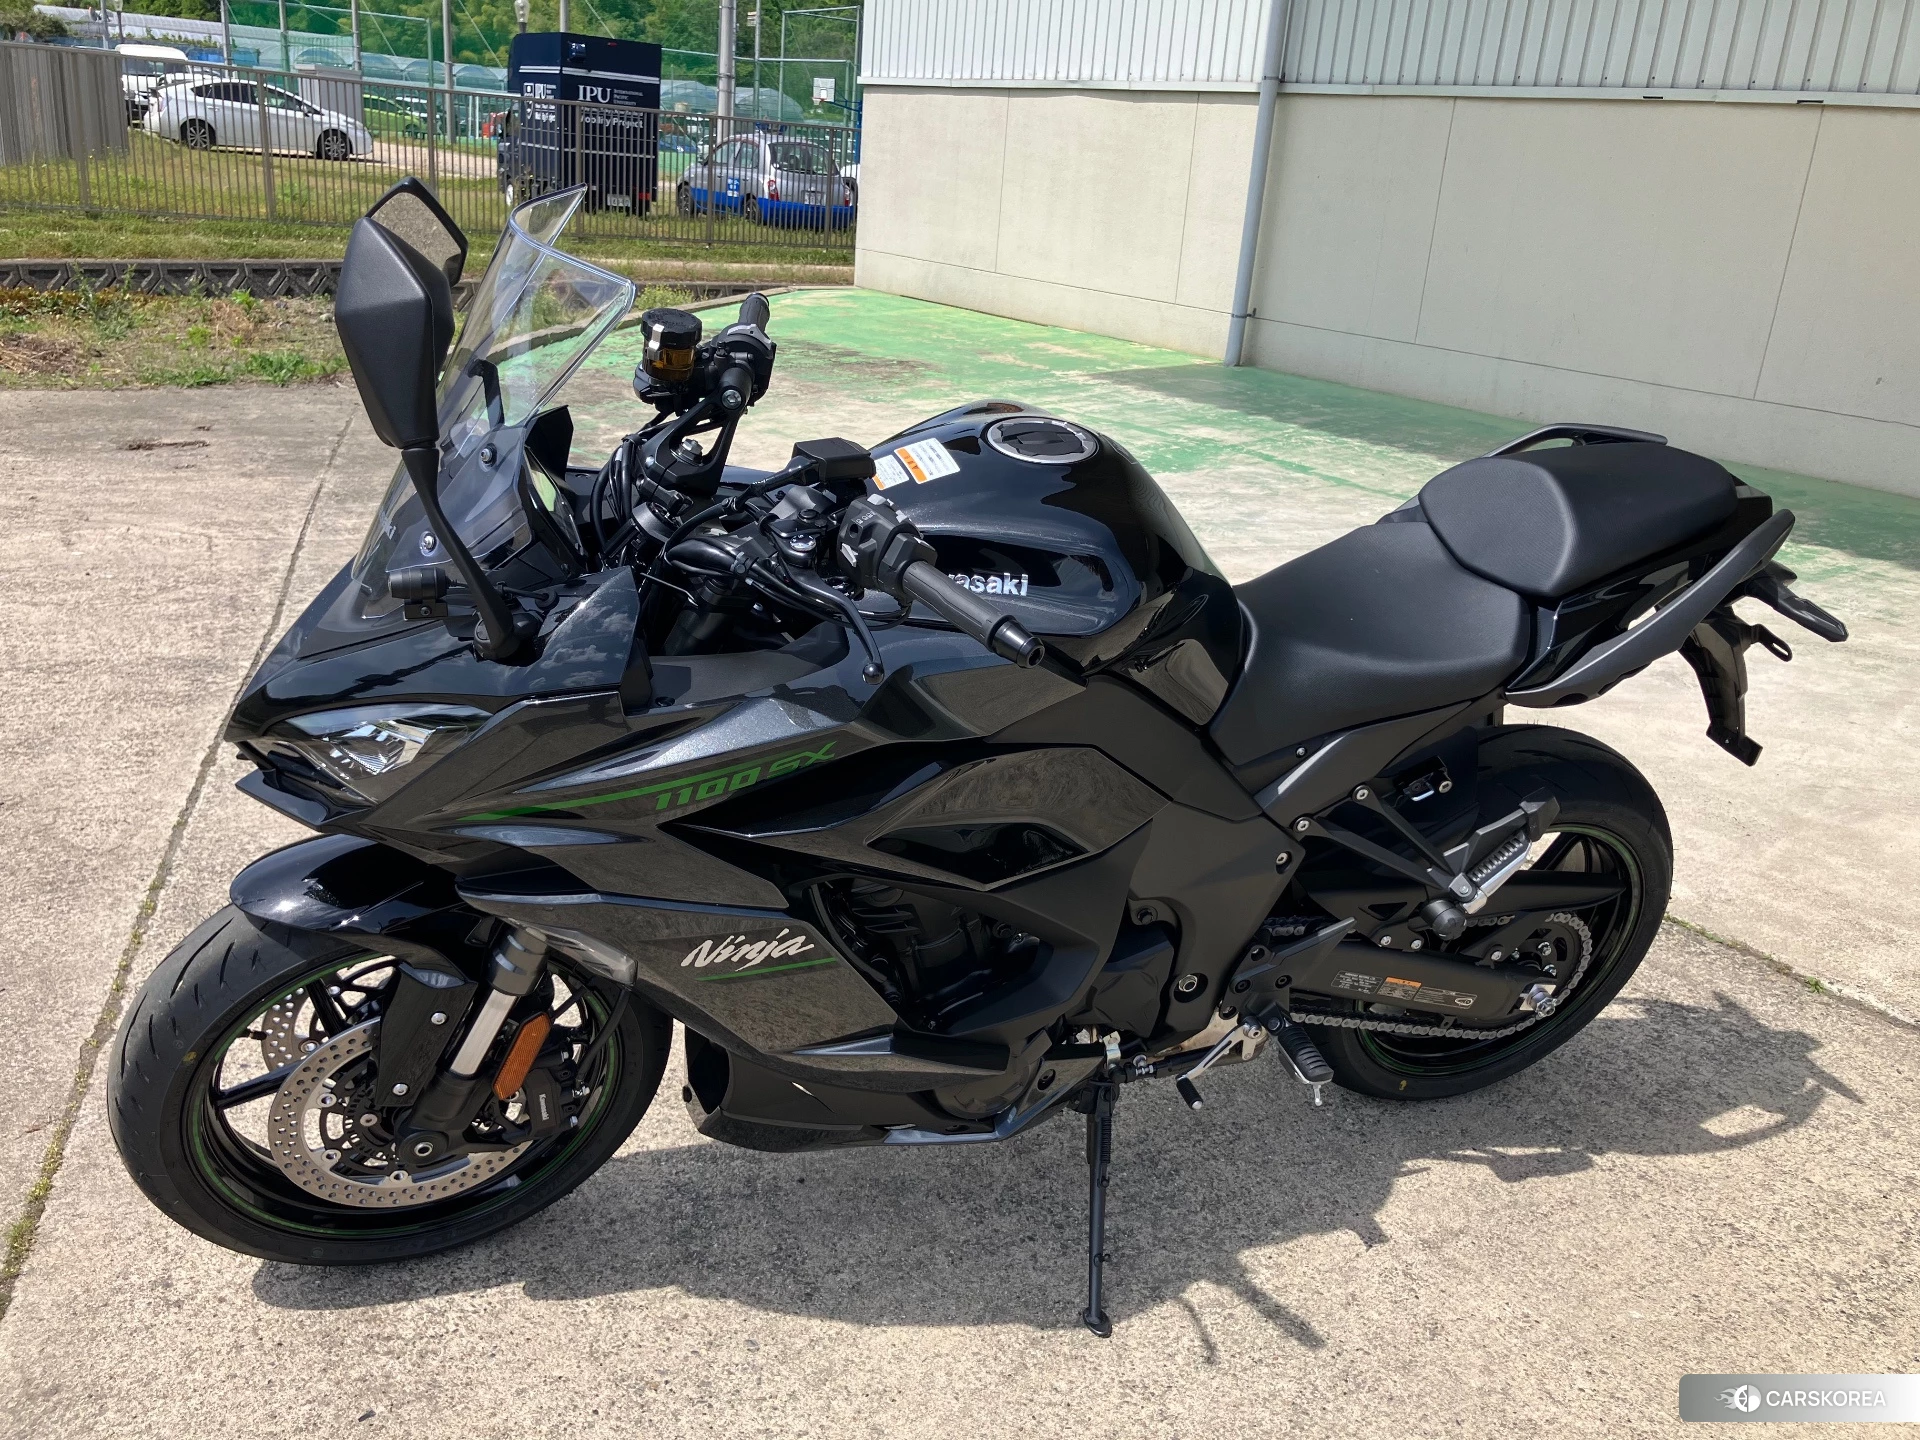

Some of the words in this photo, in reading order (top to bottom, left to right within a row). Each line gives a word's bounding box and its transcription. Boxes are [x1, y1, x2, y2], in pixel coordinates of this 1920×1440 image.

[578, 85, 612, 103] IPU
[613, 117, 644, 129] Project
[948, 572, 1028, 597] asaki
[655, 767, 762, 811] 1100
[767, 740, 837, 779] SX
[680, 928, 815, 972] Ninja
